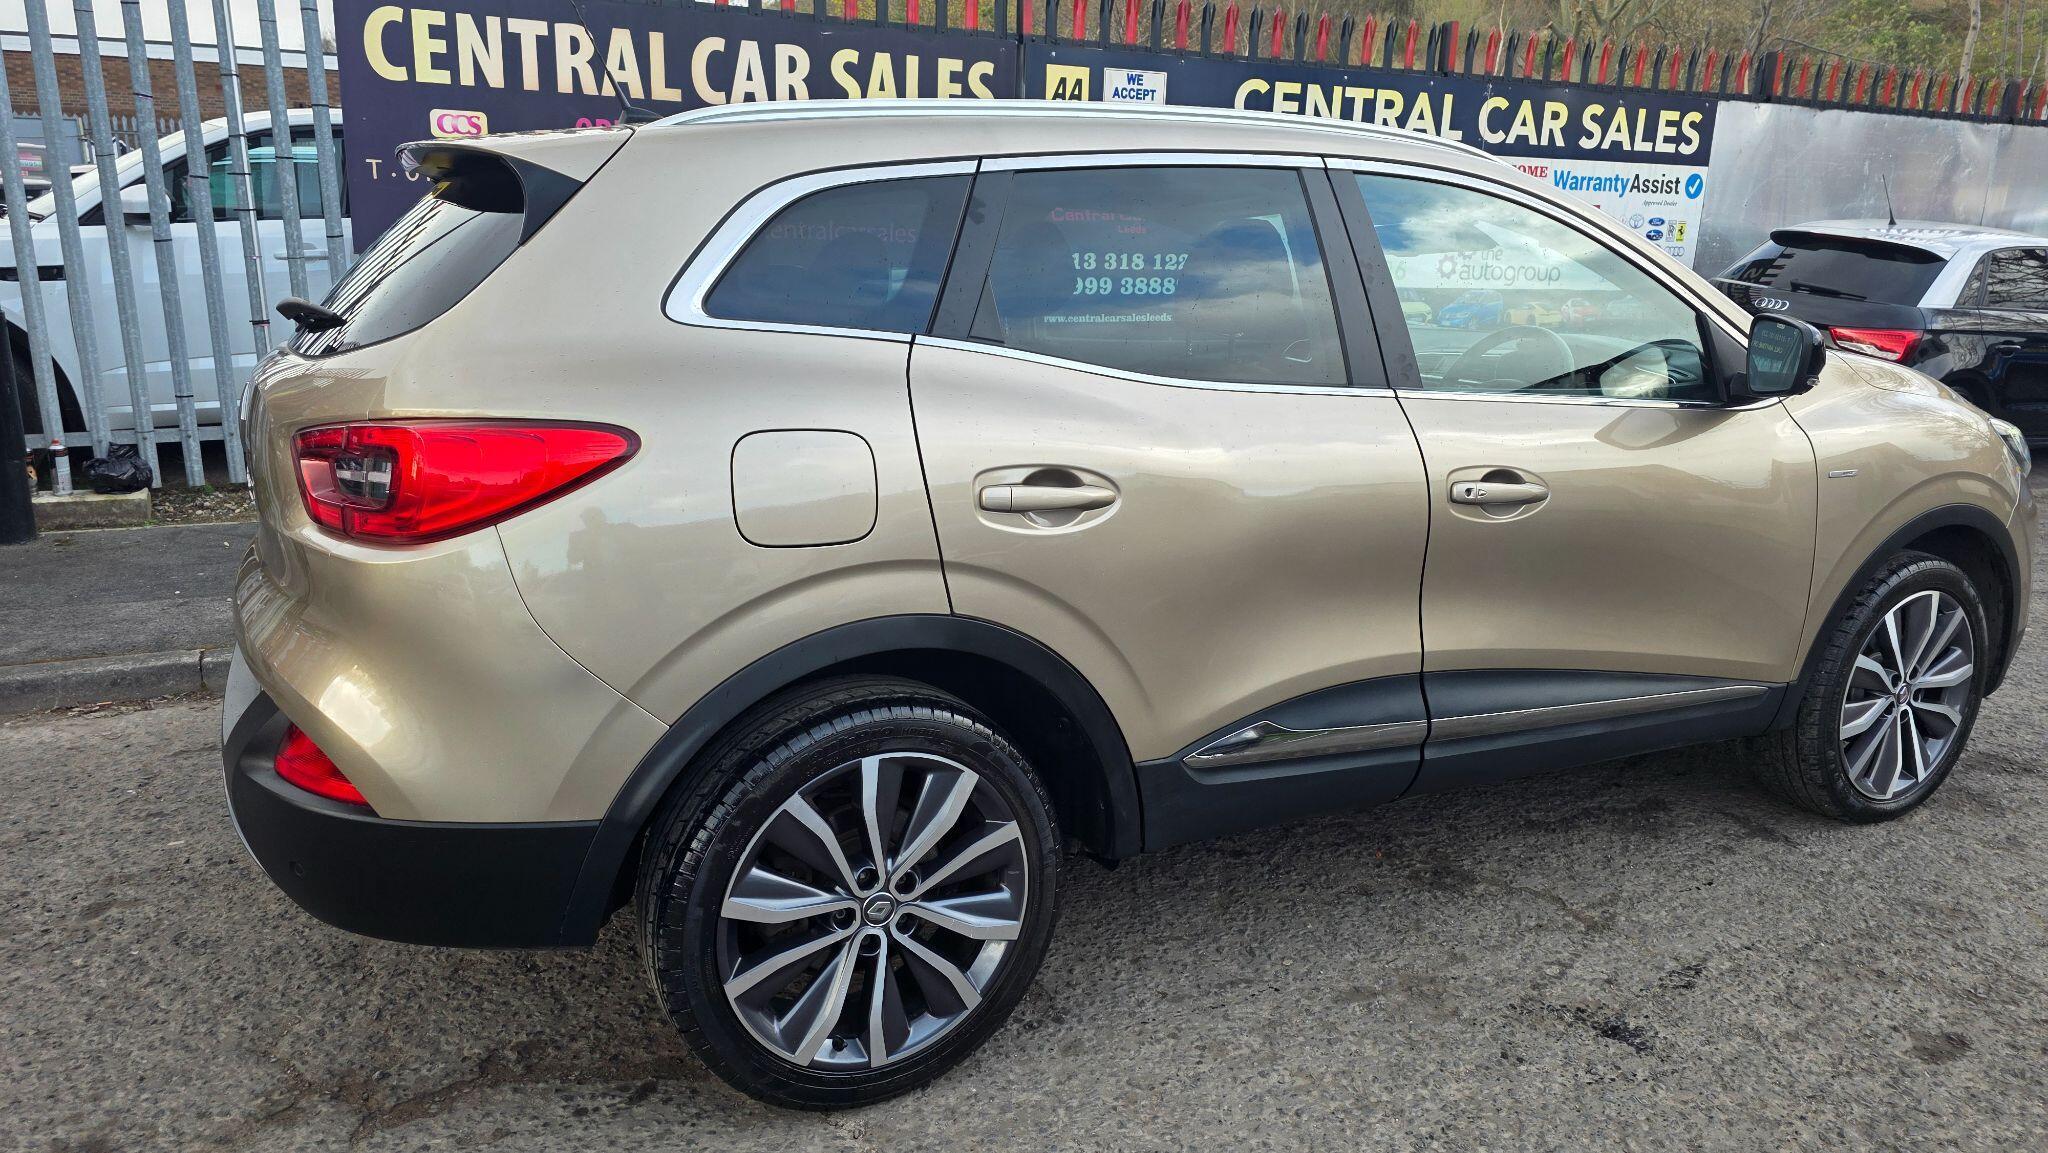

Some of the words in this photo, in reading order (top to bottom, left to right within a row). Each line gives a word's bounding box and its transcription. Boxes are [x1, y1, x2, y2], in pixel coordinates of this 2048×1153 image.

[363, 5, 682, 102] CENTRAL
[691, 36, 811, 105] CAR
[831, 48, 995, 100] SALES
[1051, 76, 1083, 101] AA
[1126, 73, 1144, 86] WE
[1112, 86, 1157, 101] ACCEPT
[1234, 78, 1463, 142] CENTRAL
[1478, 96, 1569, 147] CAR
[1578, 103, 1704, 155] SALES
[1512, 164, 1548, 178] OME
[1553, 169, 1681, 198] WarrantyAssist
[1104, 252, 1145, 270] 318
[1458, 262, 1561, 286] autogroup
